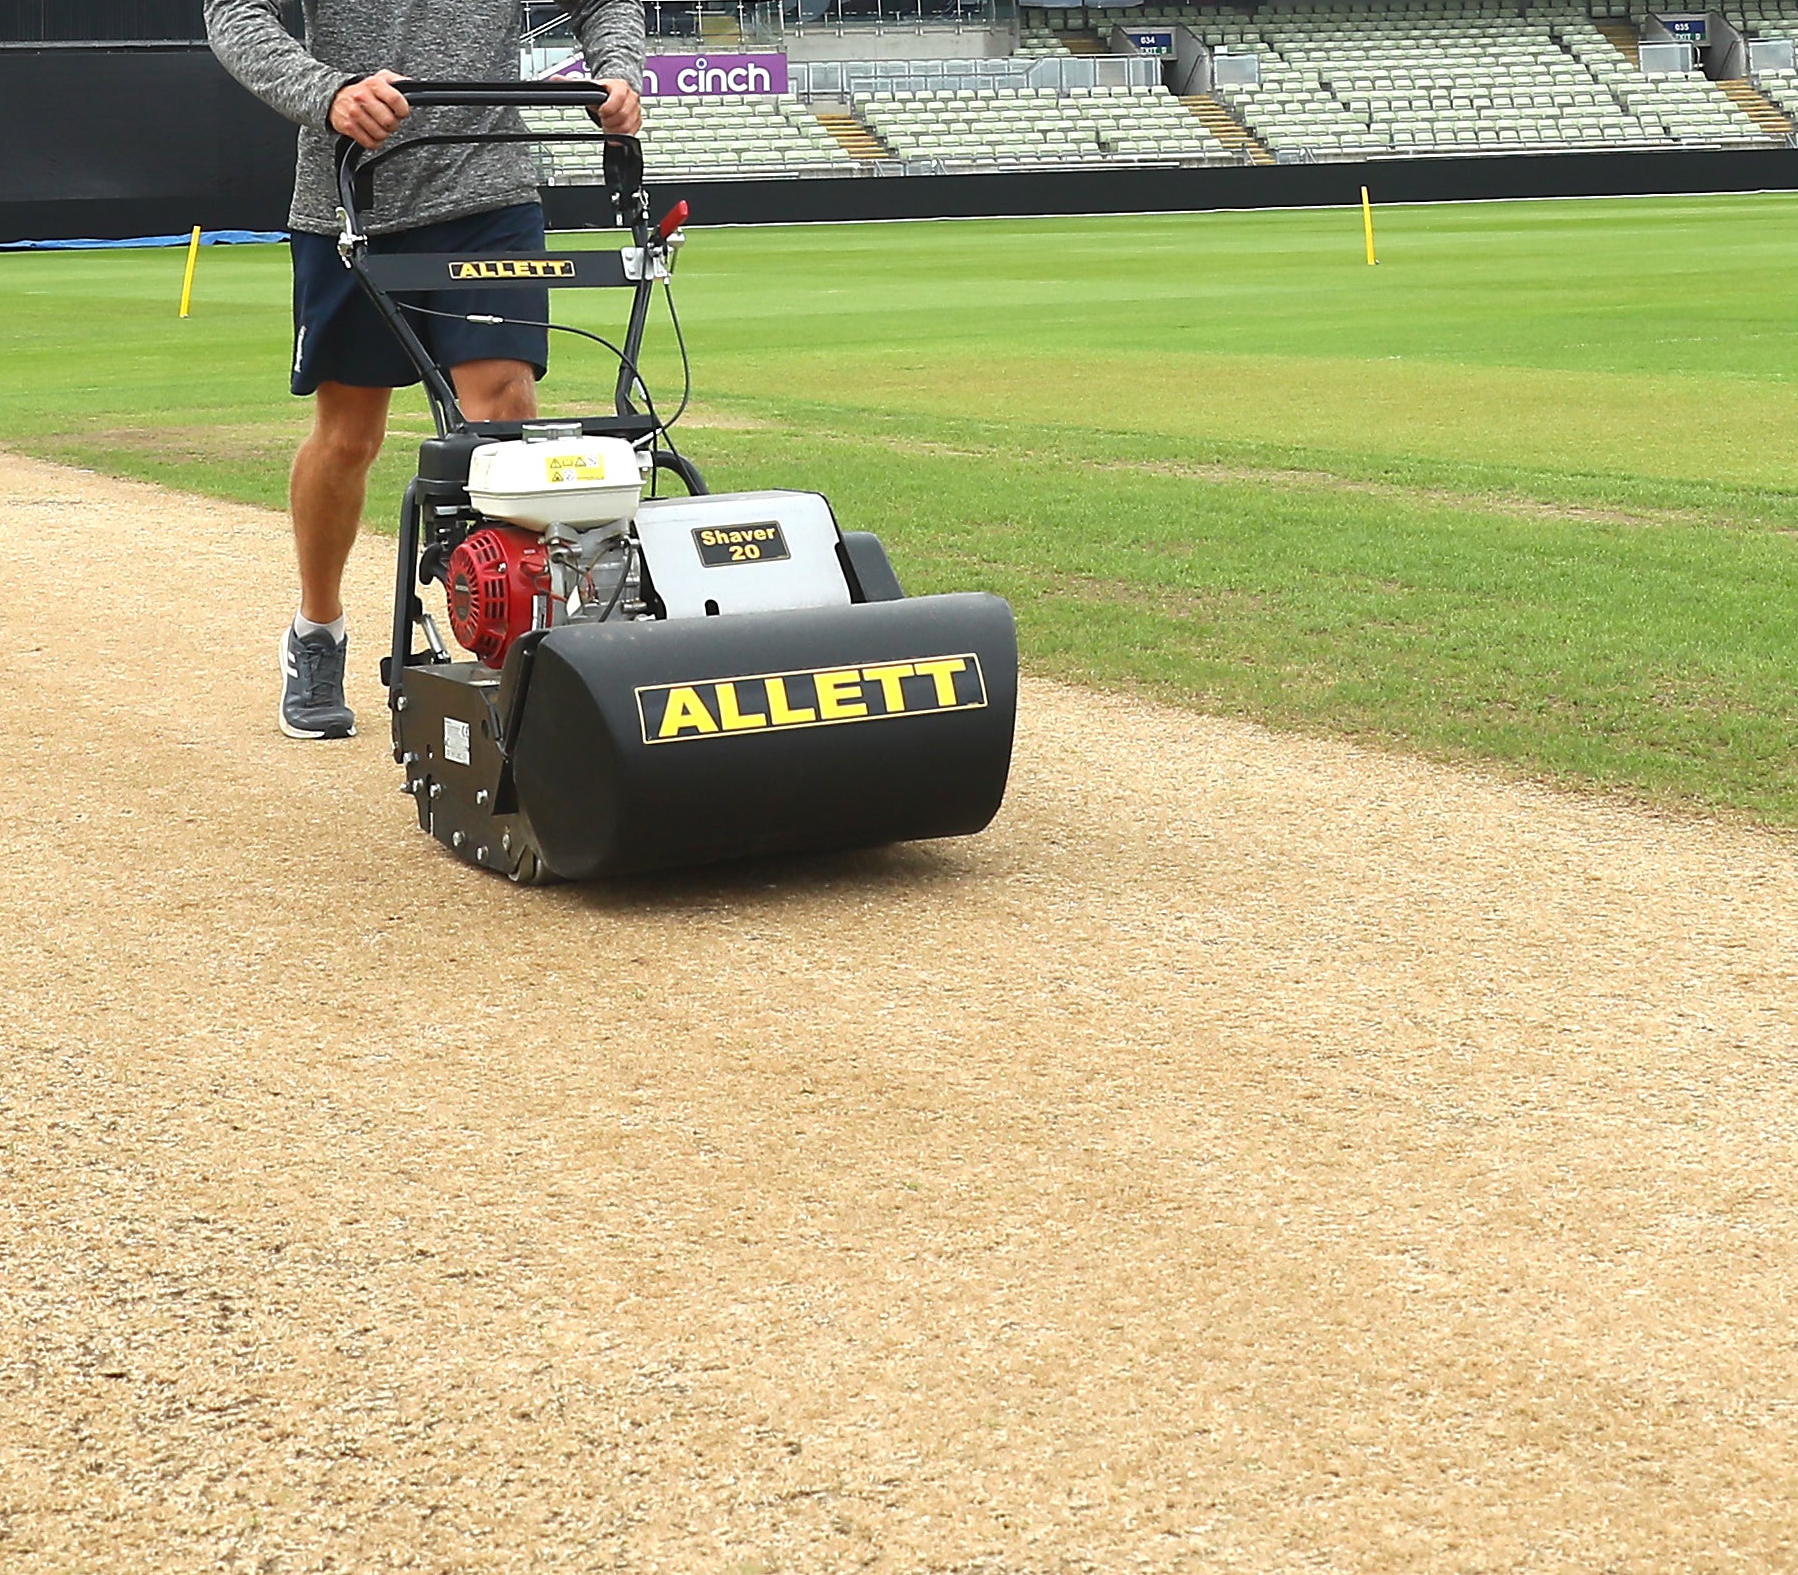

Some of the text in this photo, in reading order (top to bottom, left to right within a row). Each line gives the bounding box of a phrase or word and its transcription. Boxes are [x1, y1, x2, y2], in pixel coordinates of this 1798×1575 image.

[677, 57, 771, 93] cinch
[459, 261, 566, 278] ALLETT
[701, 528, 775, 545] Shaver
[729, 544, 760, 560] 20
[658, 658, 966, 738] ALLETT
